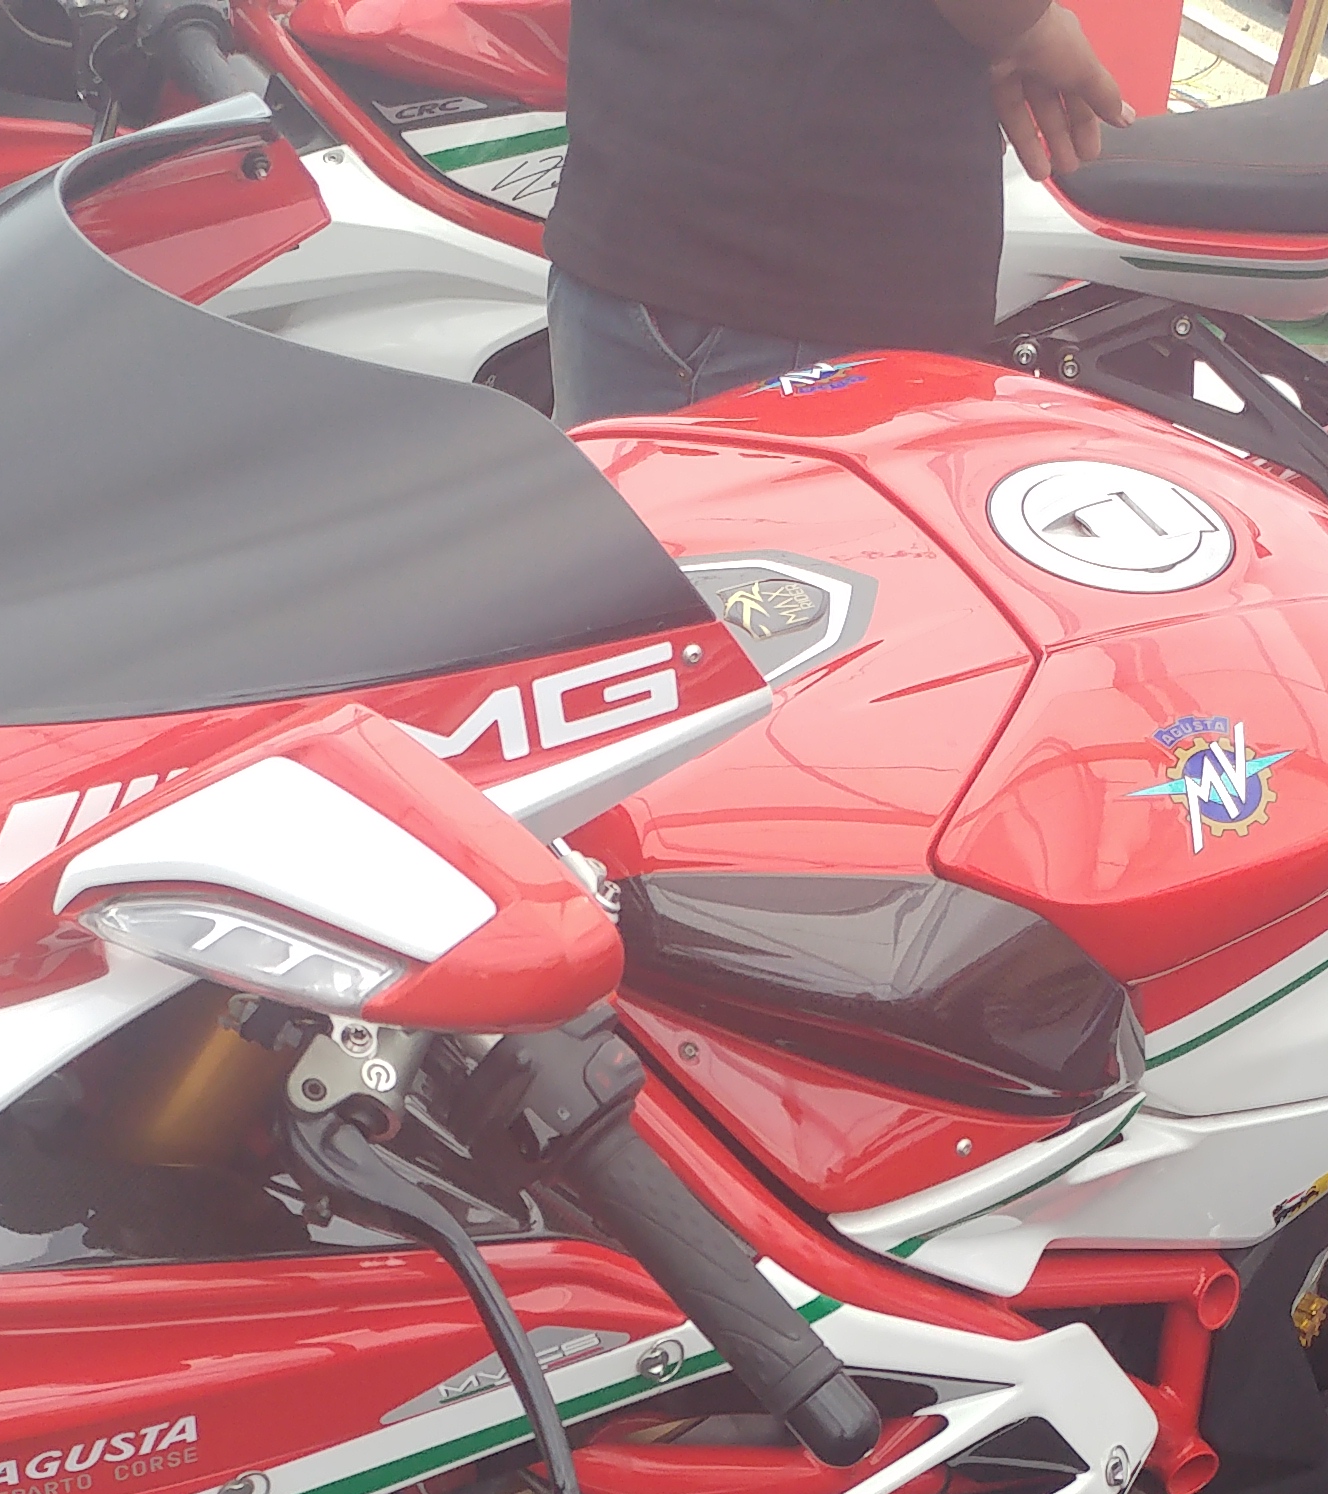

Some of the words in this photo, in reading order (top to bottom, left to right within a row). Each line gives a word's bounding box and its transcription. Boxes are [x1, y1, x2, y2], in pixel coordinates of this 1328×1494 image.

[395, 99, 461, 120] CRC
[760, 586, 810, 625] MAX
[784, 583, 816, 611] RIDER
[389, 642, 680, 762] MG
[1161, 720, 1226, 746] AGUSTA
[1184, 721, 1247, 855] MV
[114, 1447, 199, 1481] CORSE
